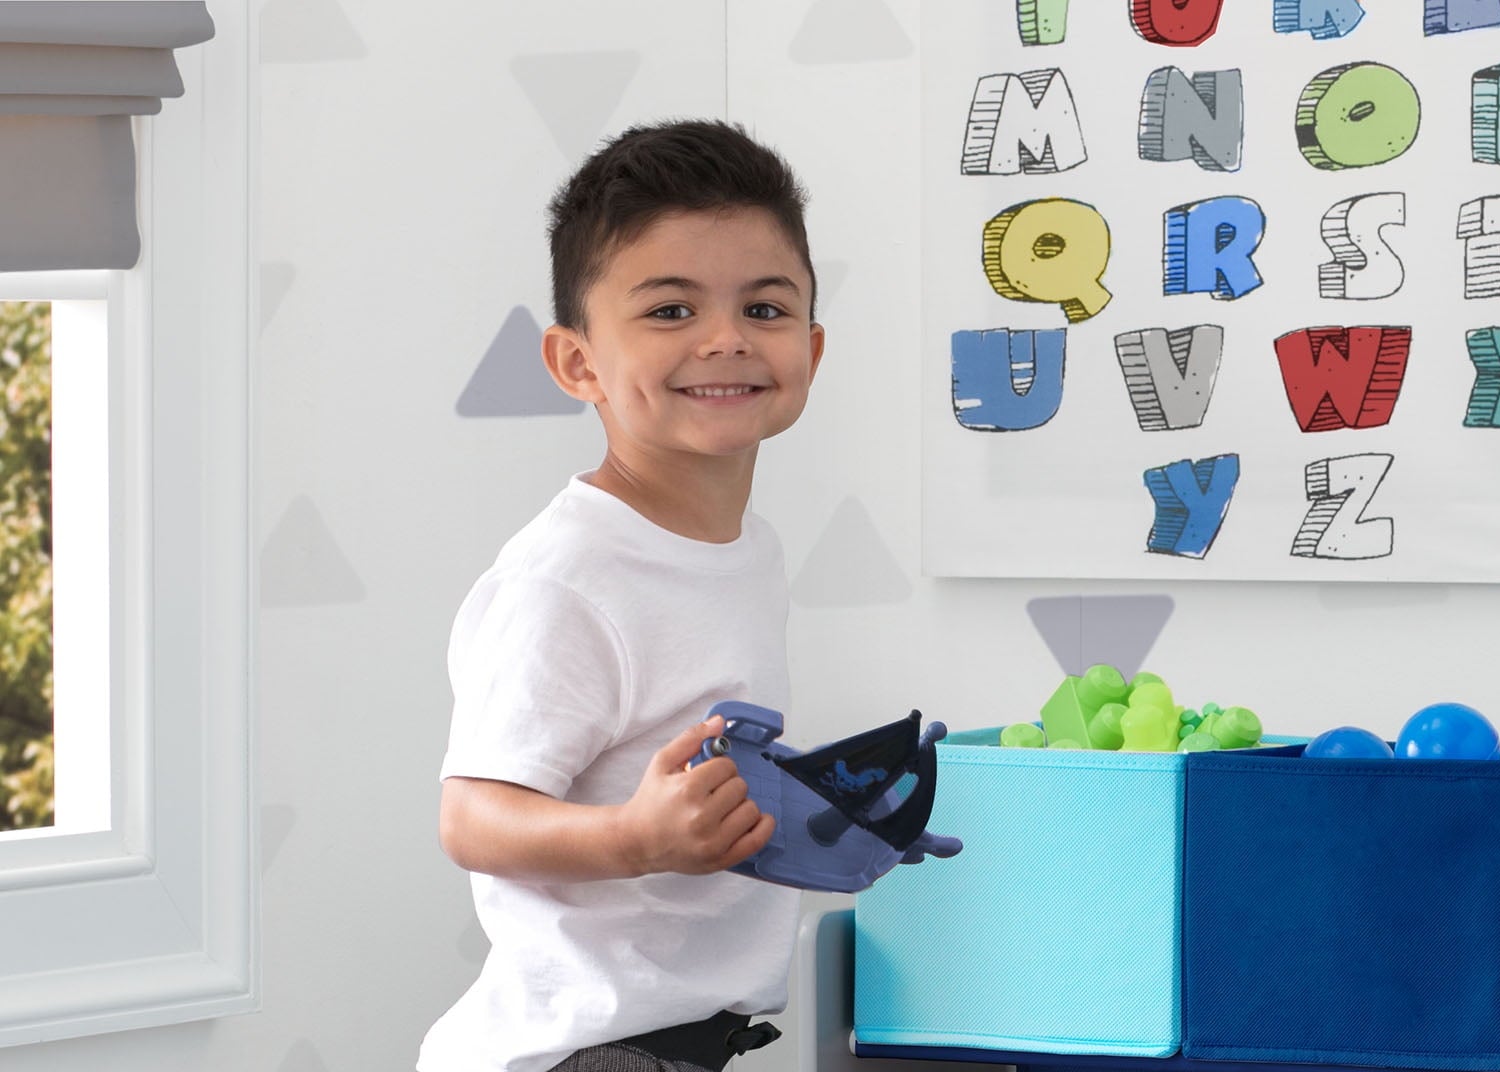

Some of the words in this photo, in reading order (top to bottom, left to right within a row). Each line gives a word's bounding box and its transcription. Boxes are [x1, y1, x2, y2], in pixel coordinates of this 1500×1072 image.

[961, 67, 1088, 175] M
[1137, 64, 1244, 172] N
[1295, 60, 1421, 171] O
[982, 197, 1113, 324] Q
[1162, 195, 1266, 301] R
[1318, 191, 1405, 300] S
[950, 327, 1068, 432] U
[1113, 324, 1224, 431] V
[1273, 324, 1412, 433] W
[1143, 453, 1239, 560] Y
[1290, 452, 1394, 560] Z
